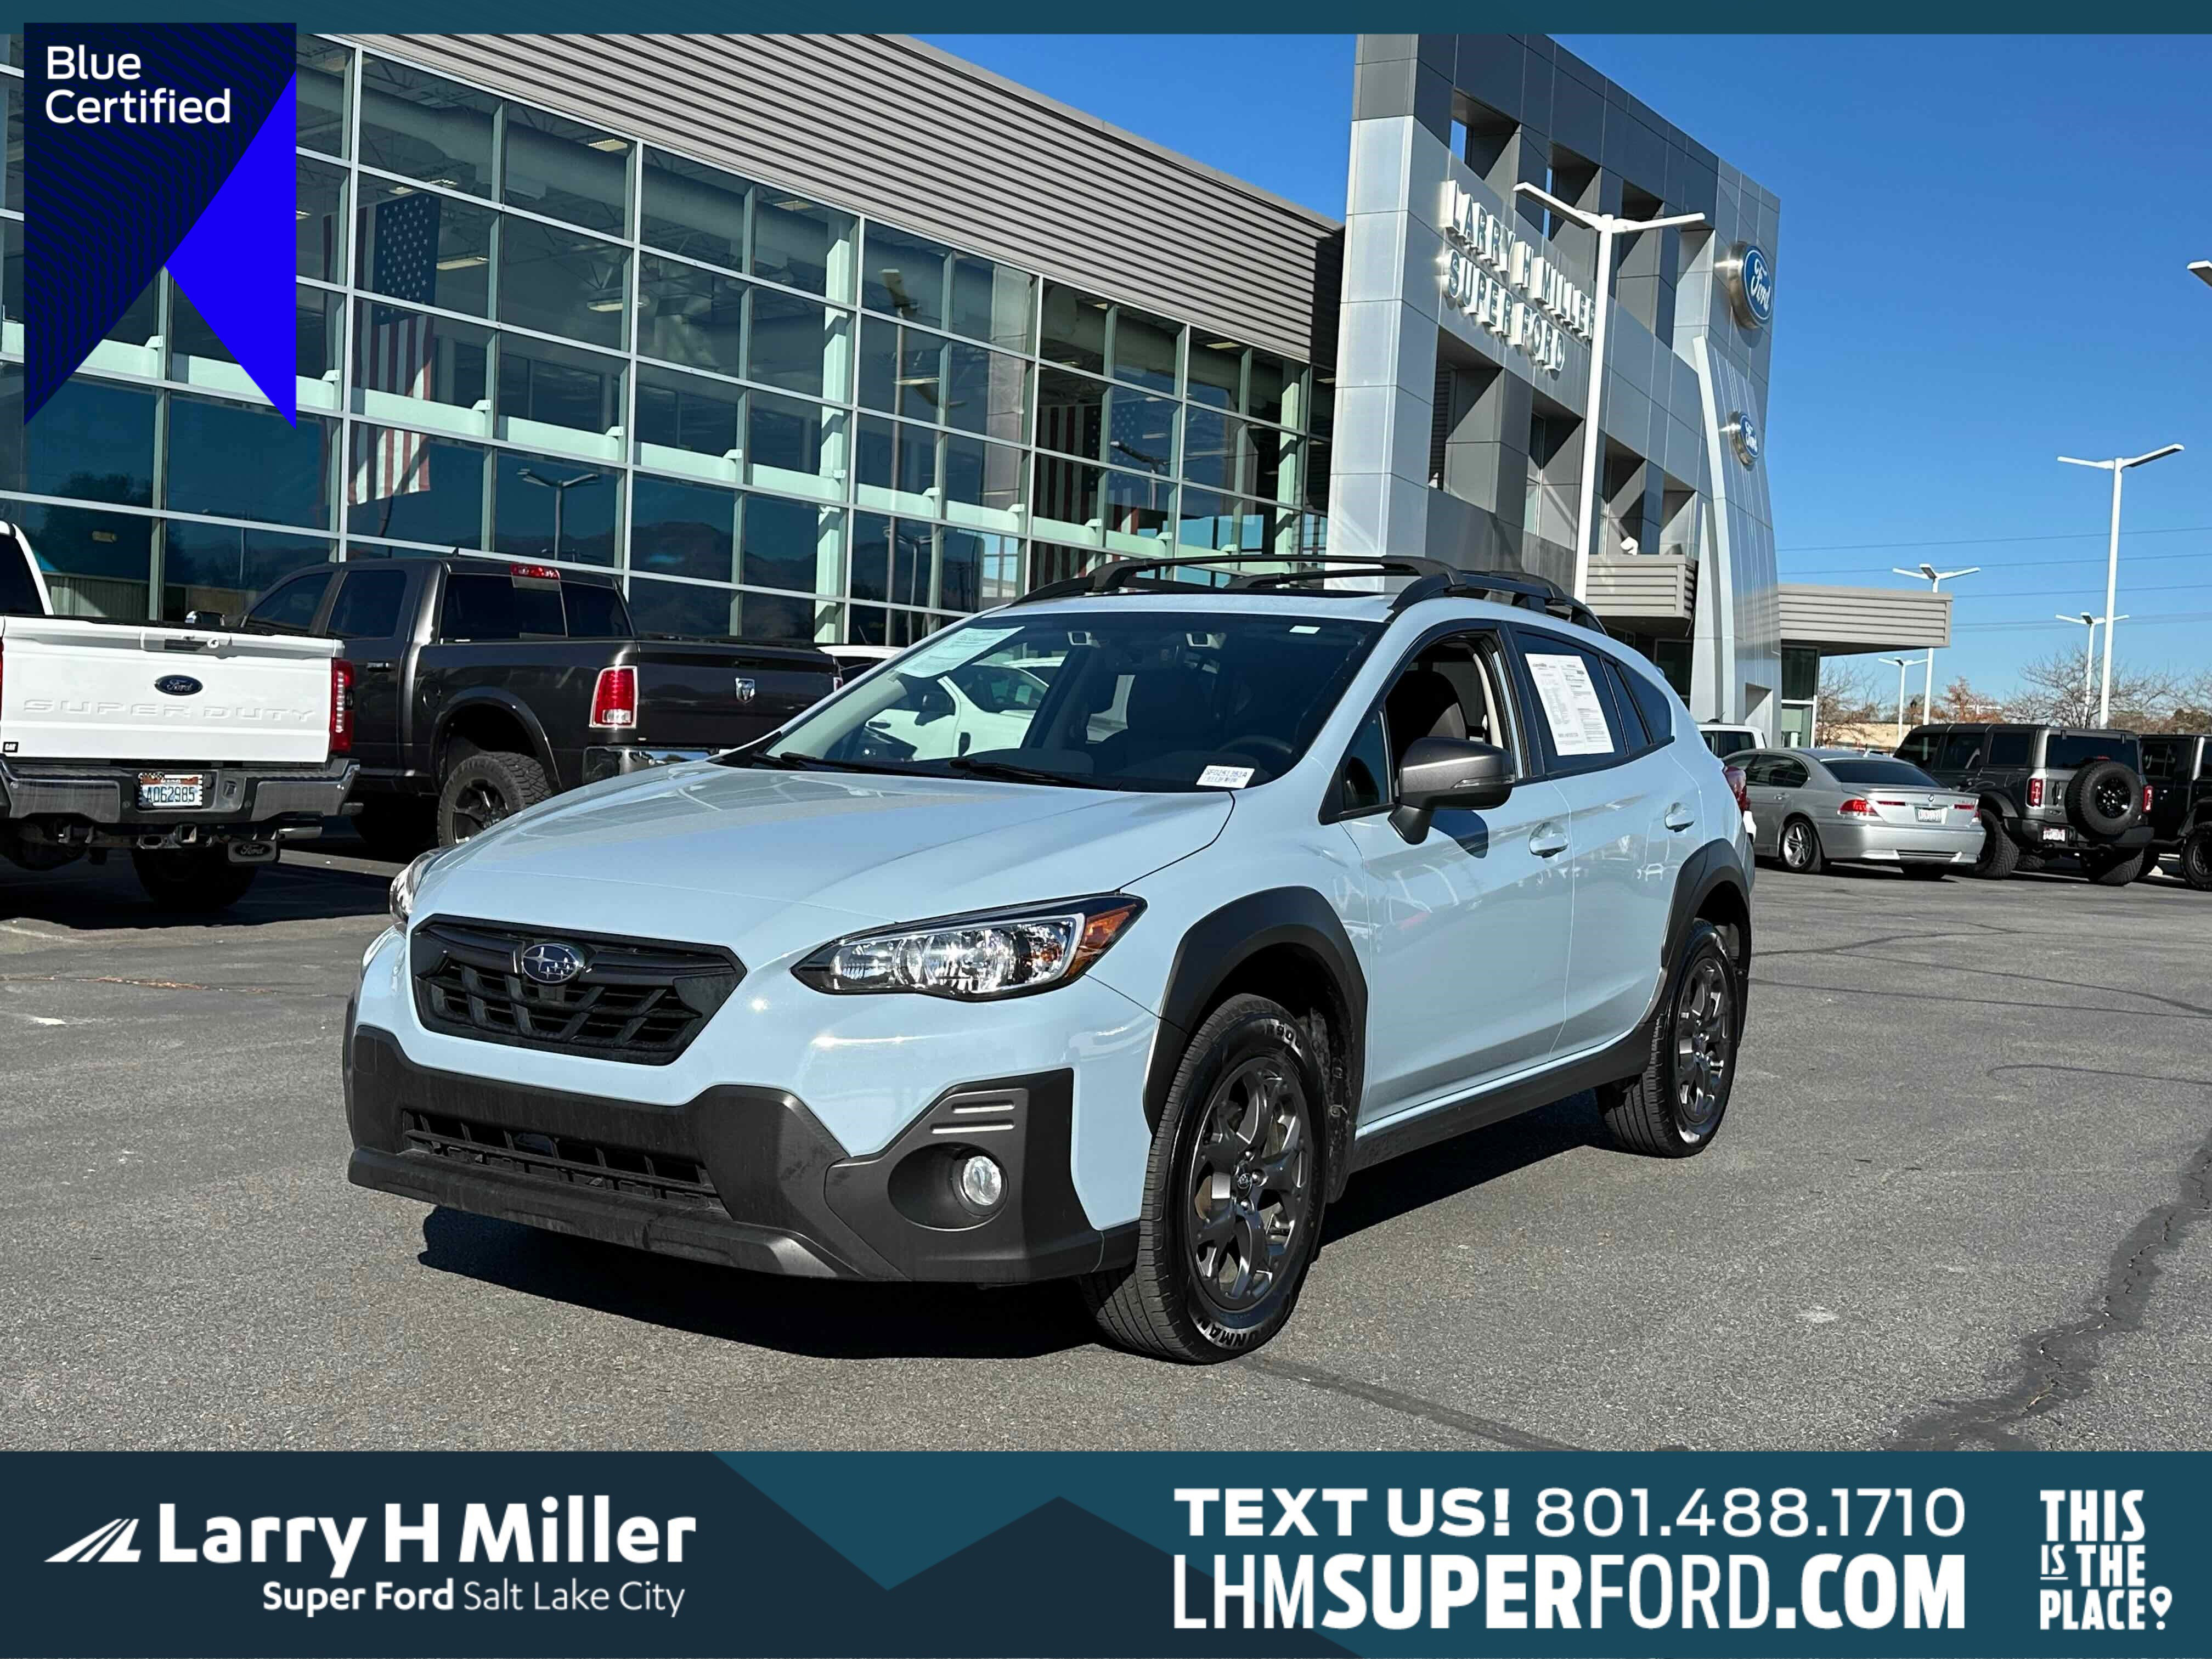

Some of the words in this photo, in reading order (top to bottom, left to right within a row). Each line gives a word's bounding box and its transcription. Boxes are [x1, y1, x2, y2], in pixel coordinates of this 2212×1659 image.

[1440, 179, 1516, 273] LARRY
[1751, 258, 1771, 312] Ford
[1440, 249, 1514, 337] SUPER
[1510, 302, 1566, 373] FORD
[166, 679, 193, 692] Ford
[23, 699, 192, 718] SUPER
[203, 706, 315, 722] DUTY
[240, 845, 264, 855] Ford
